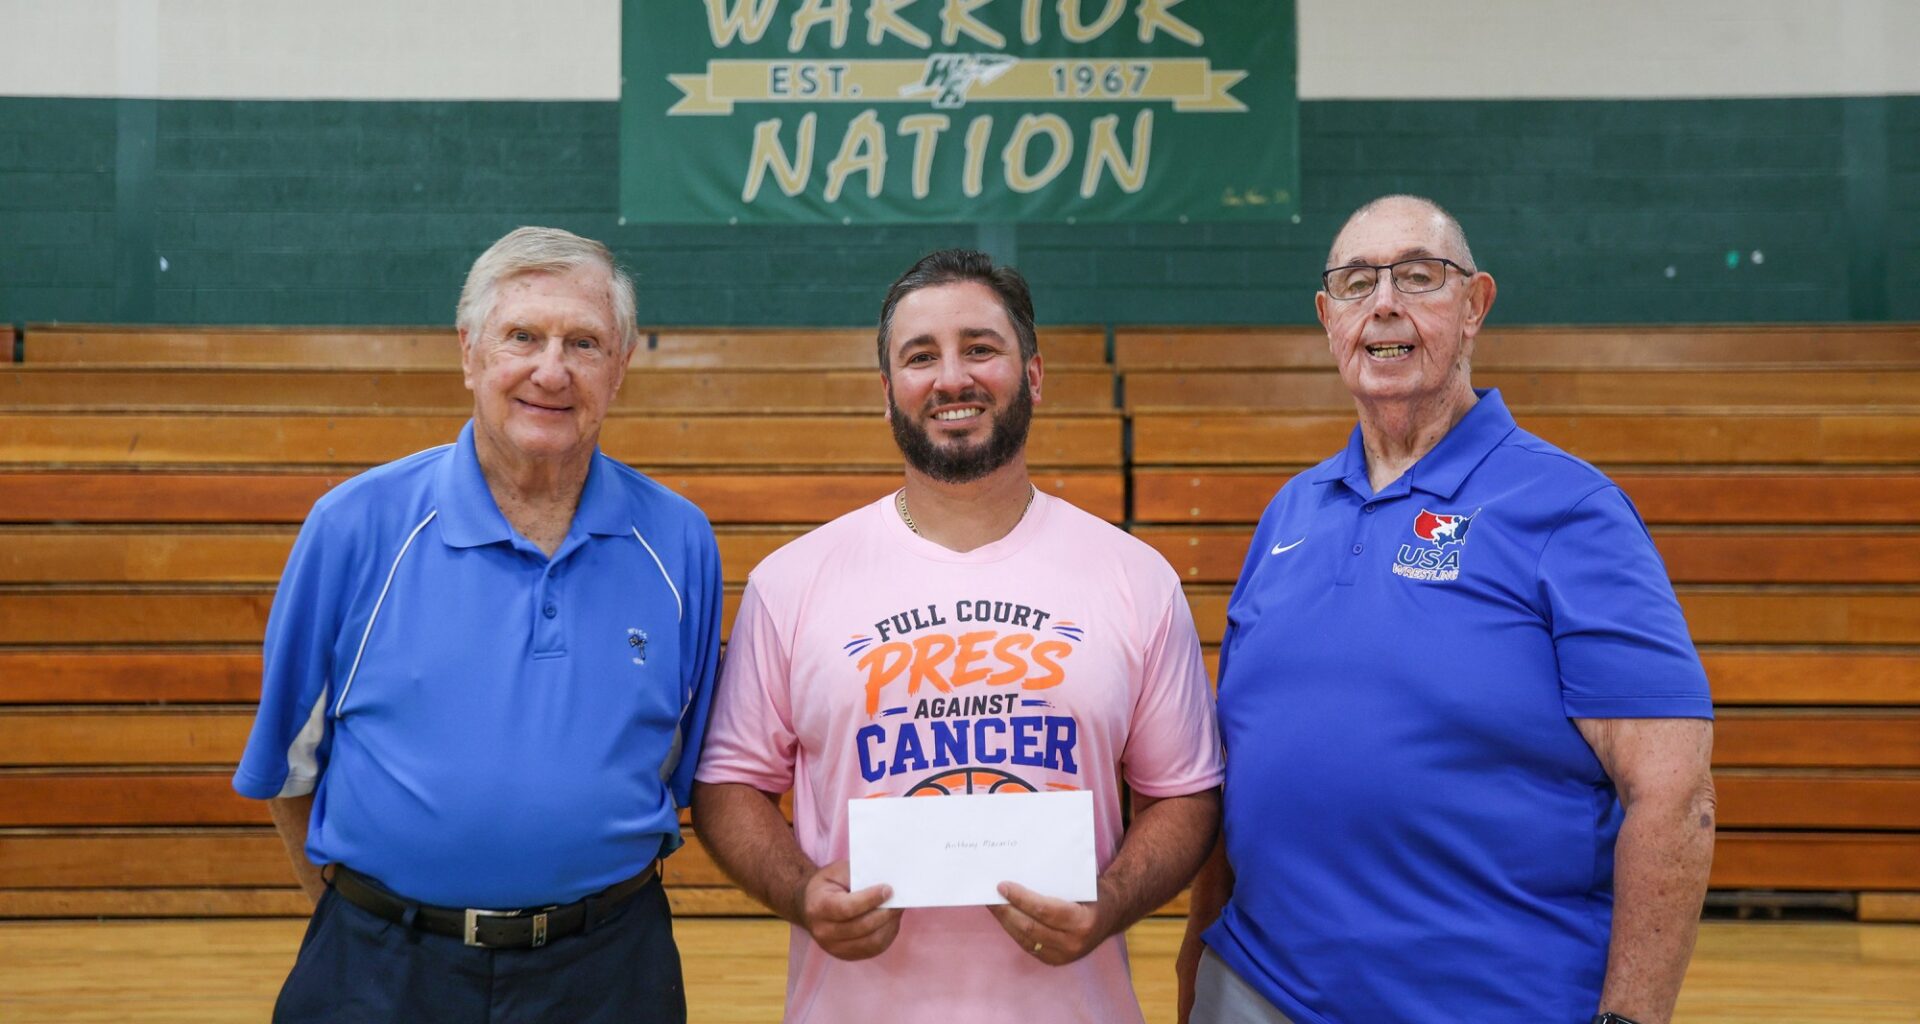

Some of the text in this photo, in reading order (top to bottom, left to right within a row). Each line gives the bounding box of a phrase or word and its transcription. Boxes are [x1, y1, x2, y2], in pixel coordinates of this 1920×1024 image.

[706, 0, 1204, 52] WARRIOR
[769, 65, 861, 97] EST.
[1053, 64, 1151, 95] 1967
[742, 108, 1154, 201] NATION
[1392, 562, 1460, 581] WRESTLING
[1397, 544, 1460, 569] USA
[875, 600, 1050, 643] FULL COURT
[856, 630, 1072, 720] PRESS
[914, 693, 1018, 719] AGAINST
[856, 716, 1078, 783] CANCER
